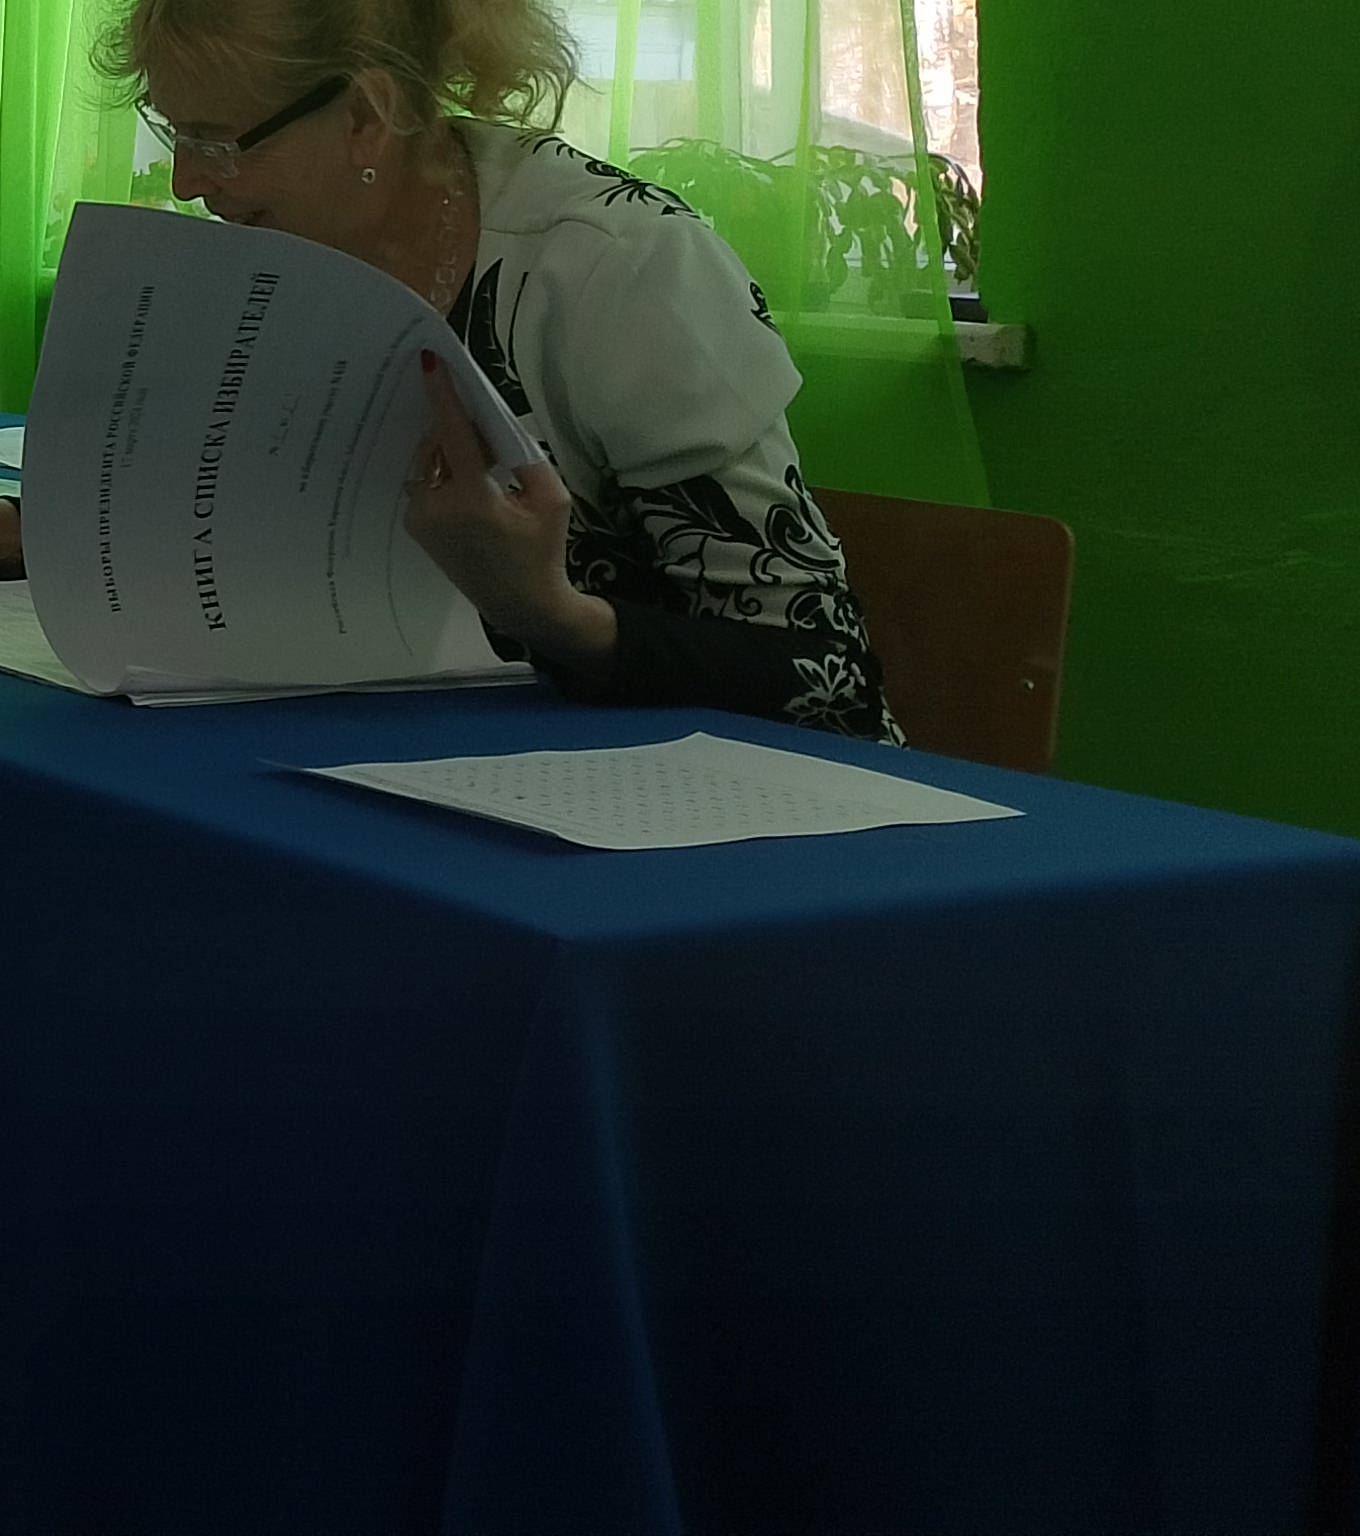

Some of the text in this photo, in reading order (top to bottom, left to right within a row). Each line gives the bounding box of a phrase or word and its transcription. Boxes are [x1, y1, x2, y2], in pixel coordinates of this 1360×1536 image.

[98, 285, 155, 613] ВЫБОРЫ ПРЕЗИДЕНТА РОССИЙСКОЙ ФЕДЕРАЦИИ
[193, 271, 280, 631] КНИГА СПИСКА ИЗБИРАТЕЛЕЙ
